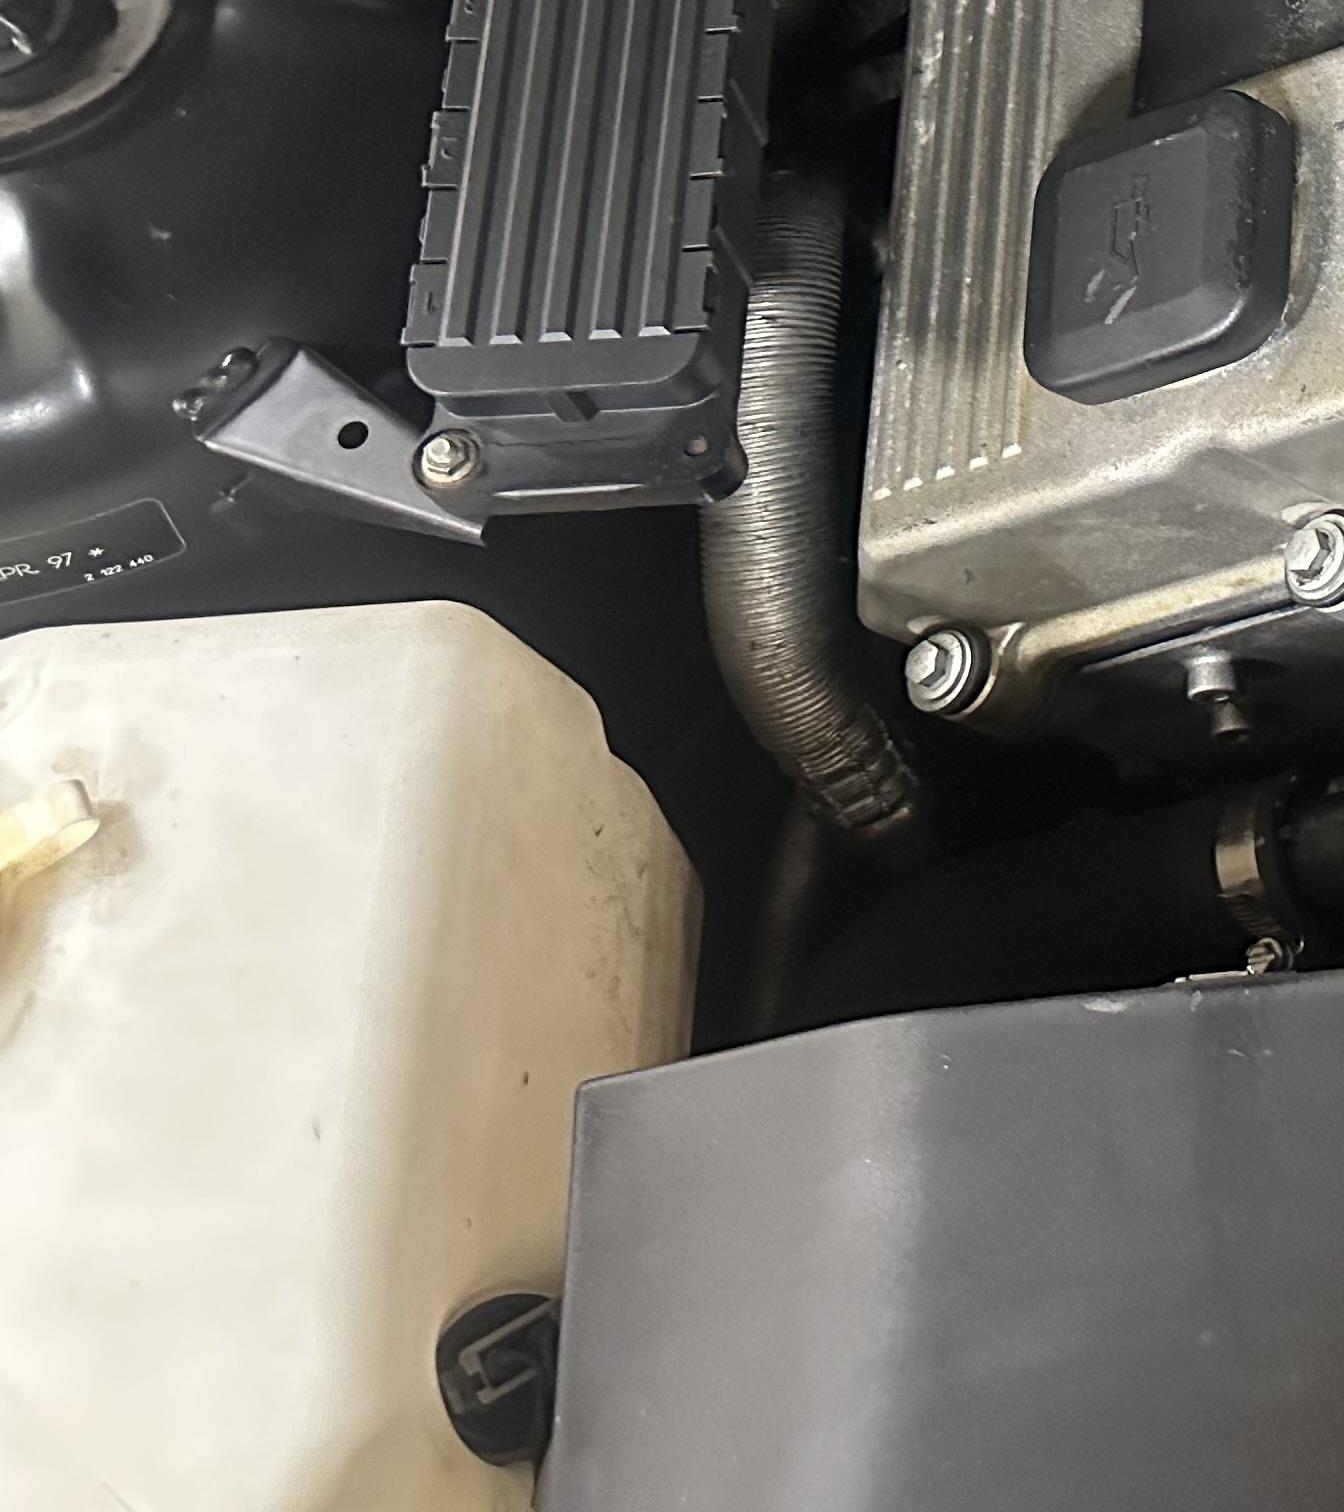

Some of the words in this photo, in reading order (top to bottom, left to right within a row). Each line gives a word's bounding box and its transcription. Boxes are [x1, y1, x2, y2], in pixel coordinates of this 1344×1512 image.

[0, 563, 40, 581] PR
[47, 551, 72, 569] 97
[84, 573, 95, 582] 2
